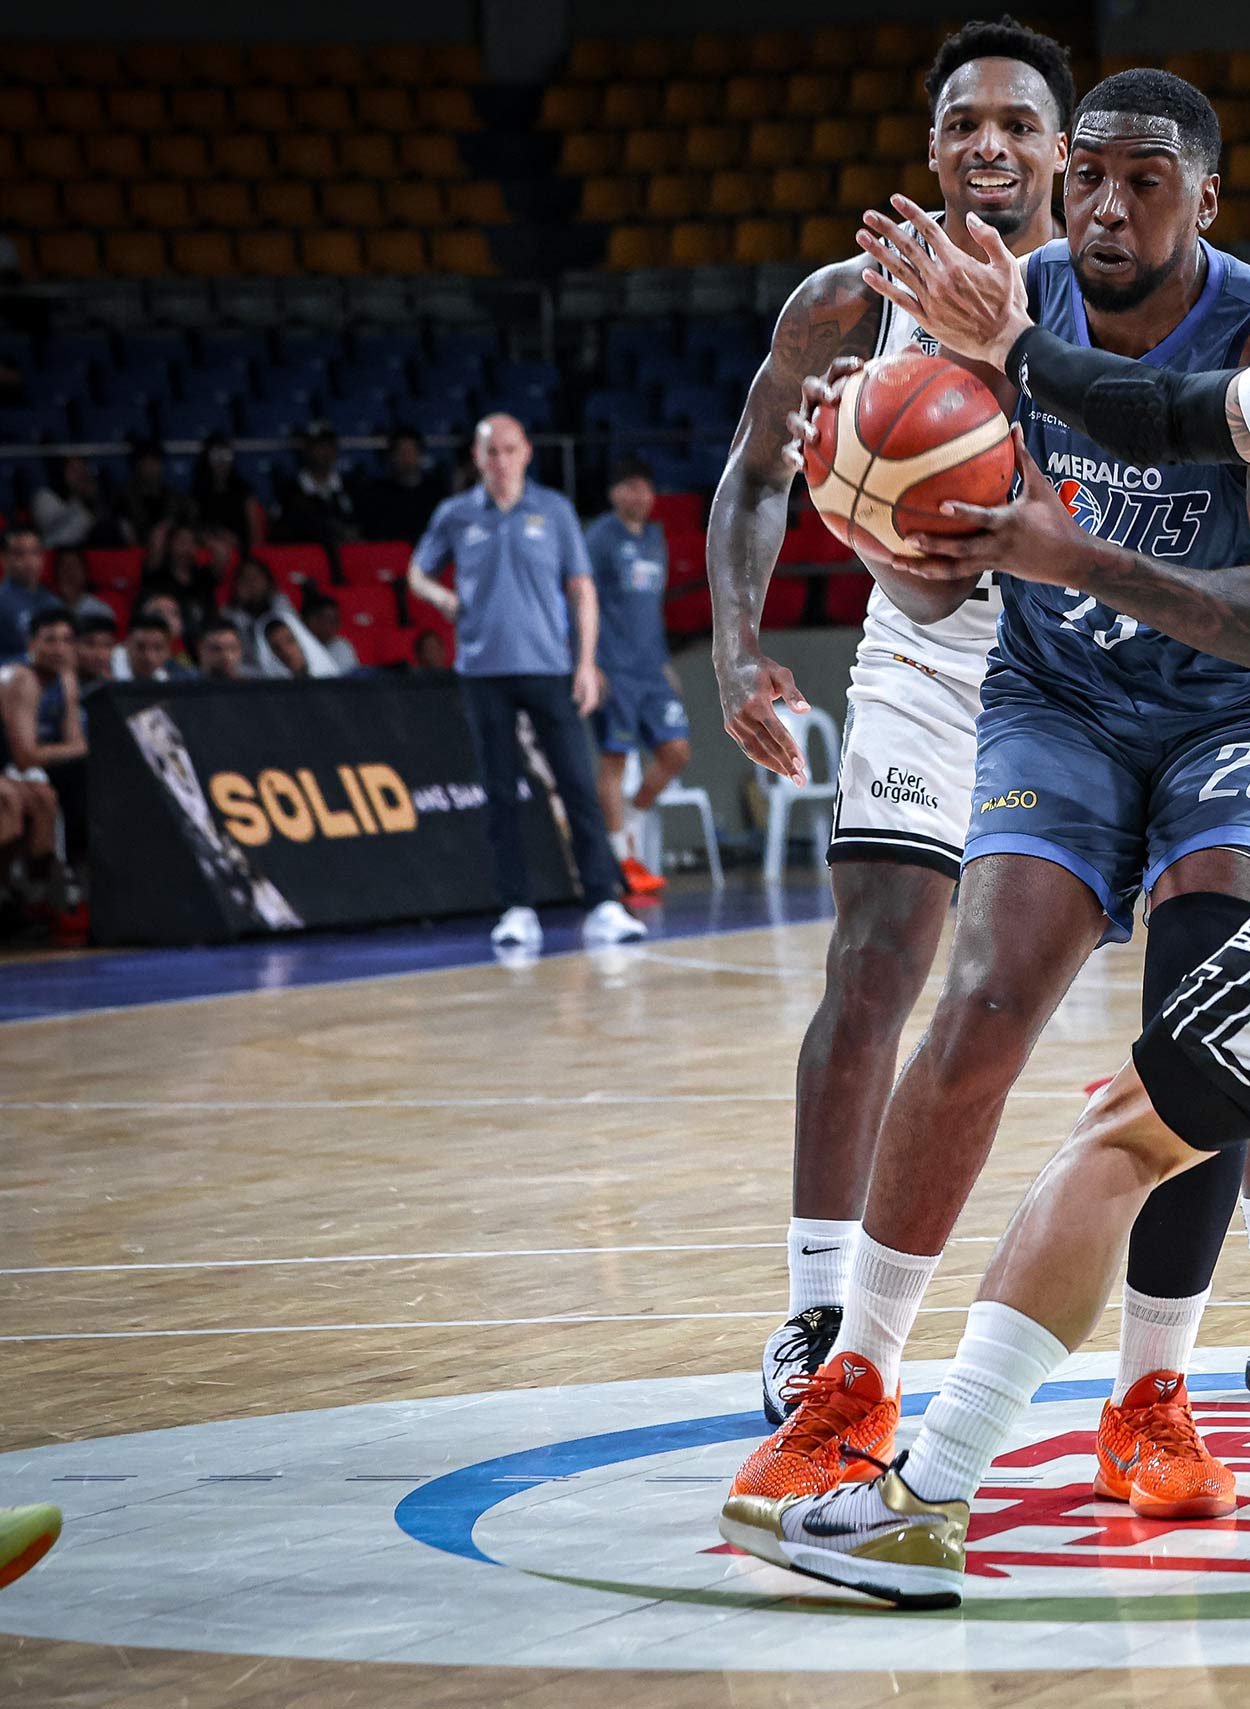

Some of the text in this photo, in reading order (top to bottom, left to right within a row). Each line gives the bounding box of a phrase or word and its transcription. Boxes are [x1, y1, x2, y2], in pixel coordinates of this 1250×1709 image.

[1030, 410, 1071, 429] SPECTR
[1047, 451, 1162, 491] MERALCO
[887, 767, 923, 789] Ever
[209, 763, 418, 847] SOLID
[871, 780, 939, 809] Organics
